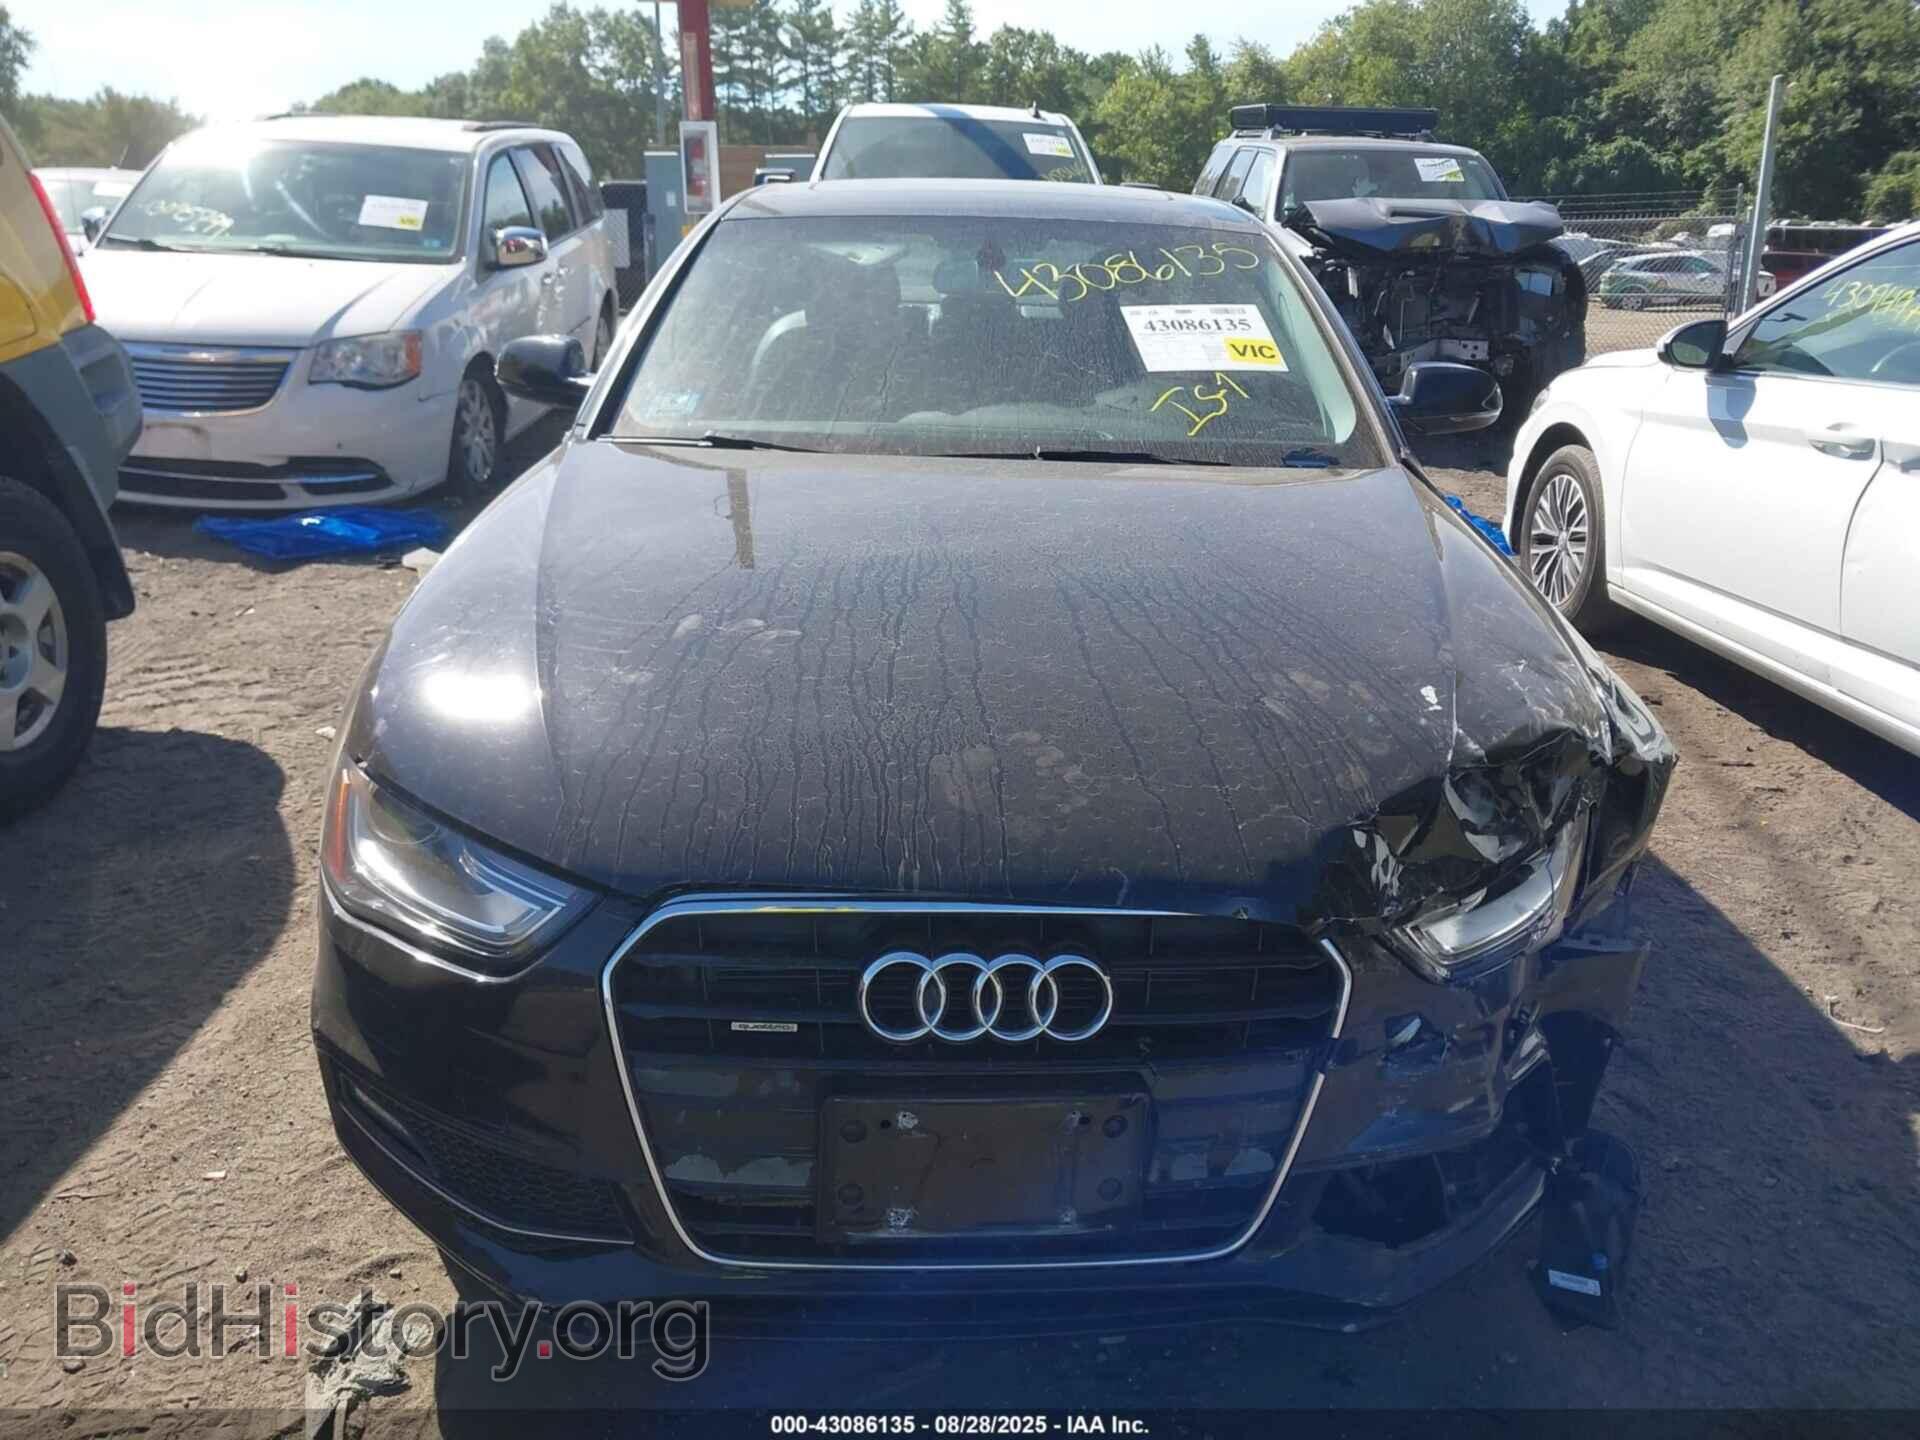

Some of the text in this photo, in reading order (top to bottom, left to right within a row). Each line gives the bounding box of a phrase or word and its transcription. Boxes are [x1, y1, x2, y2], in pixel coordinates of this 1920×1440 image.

[993, 242, 1260, 301] 43086135
[1143, 318, 1252, 333] 43086135
[1230, 343, 1276, 360] VIC
